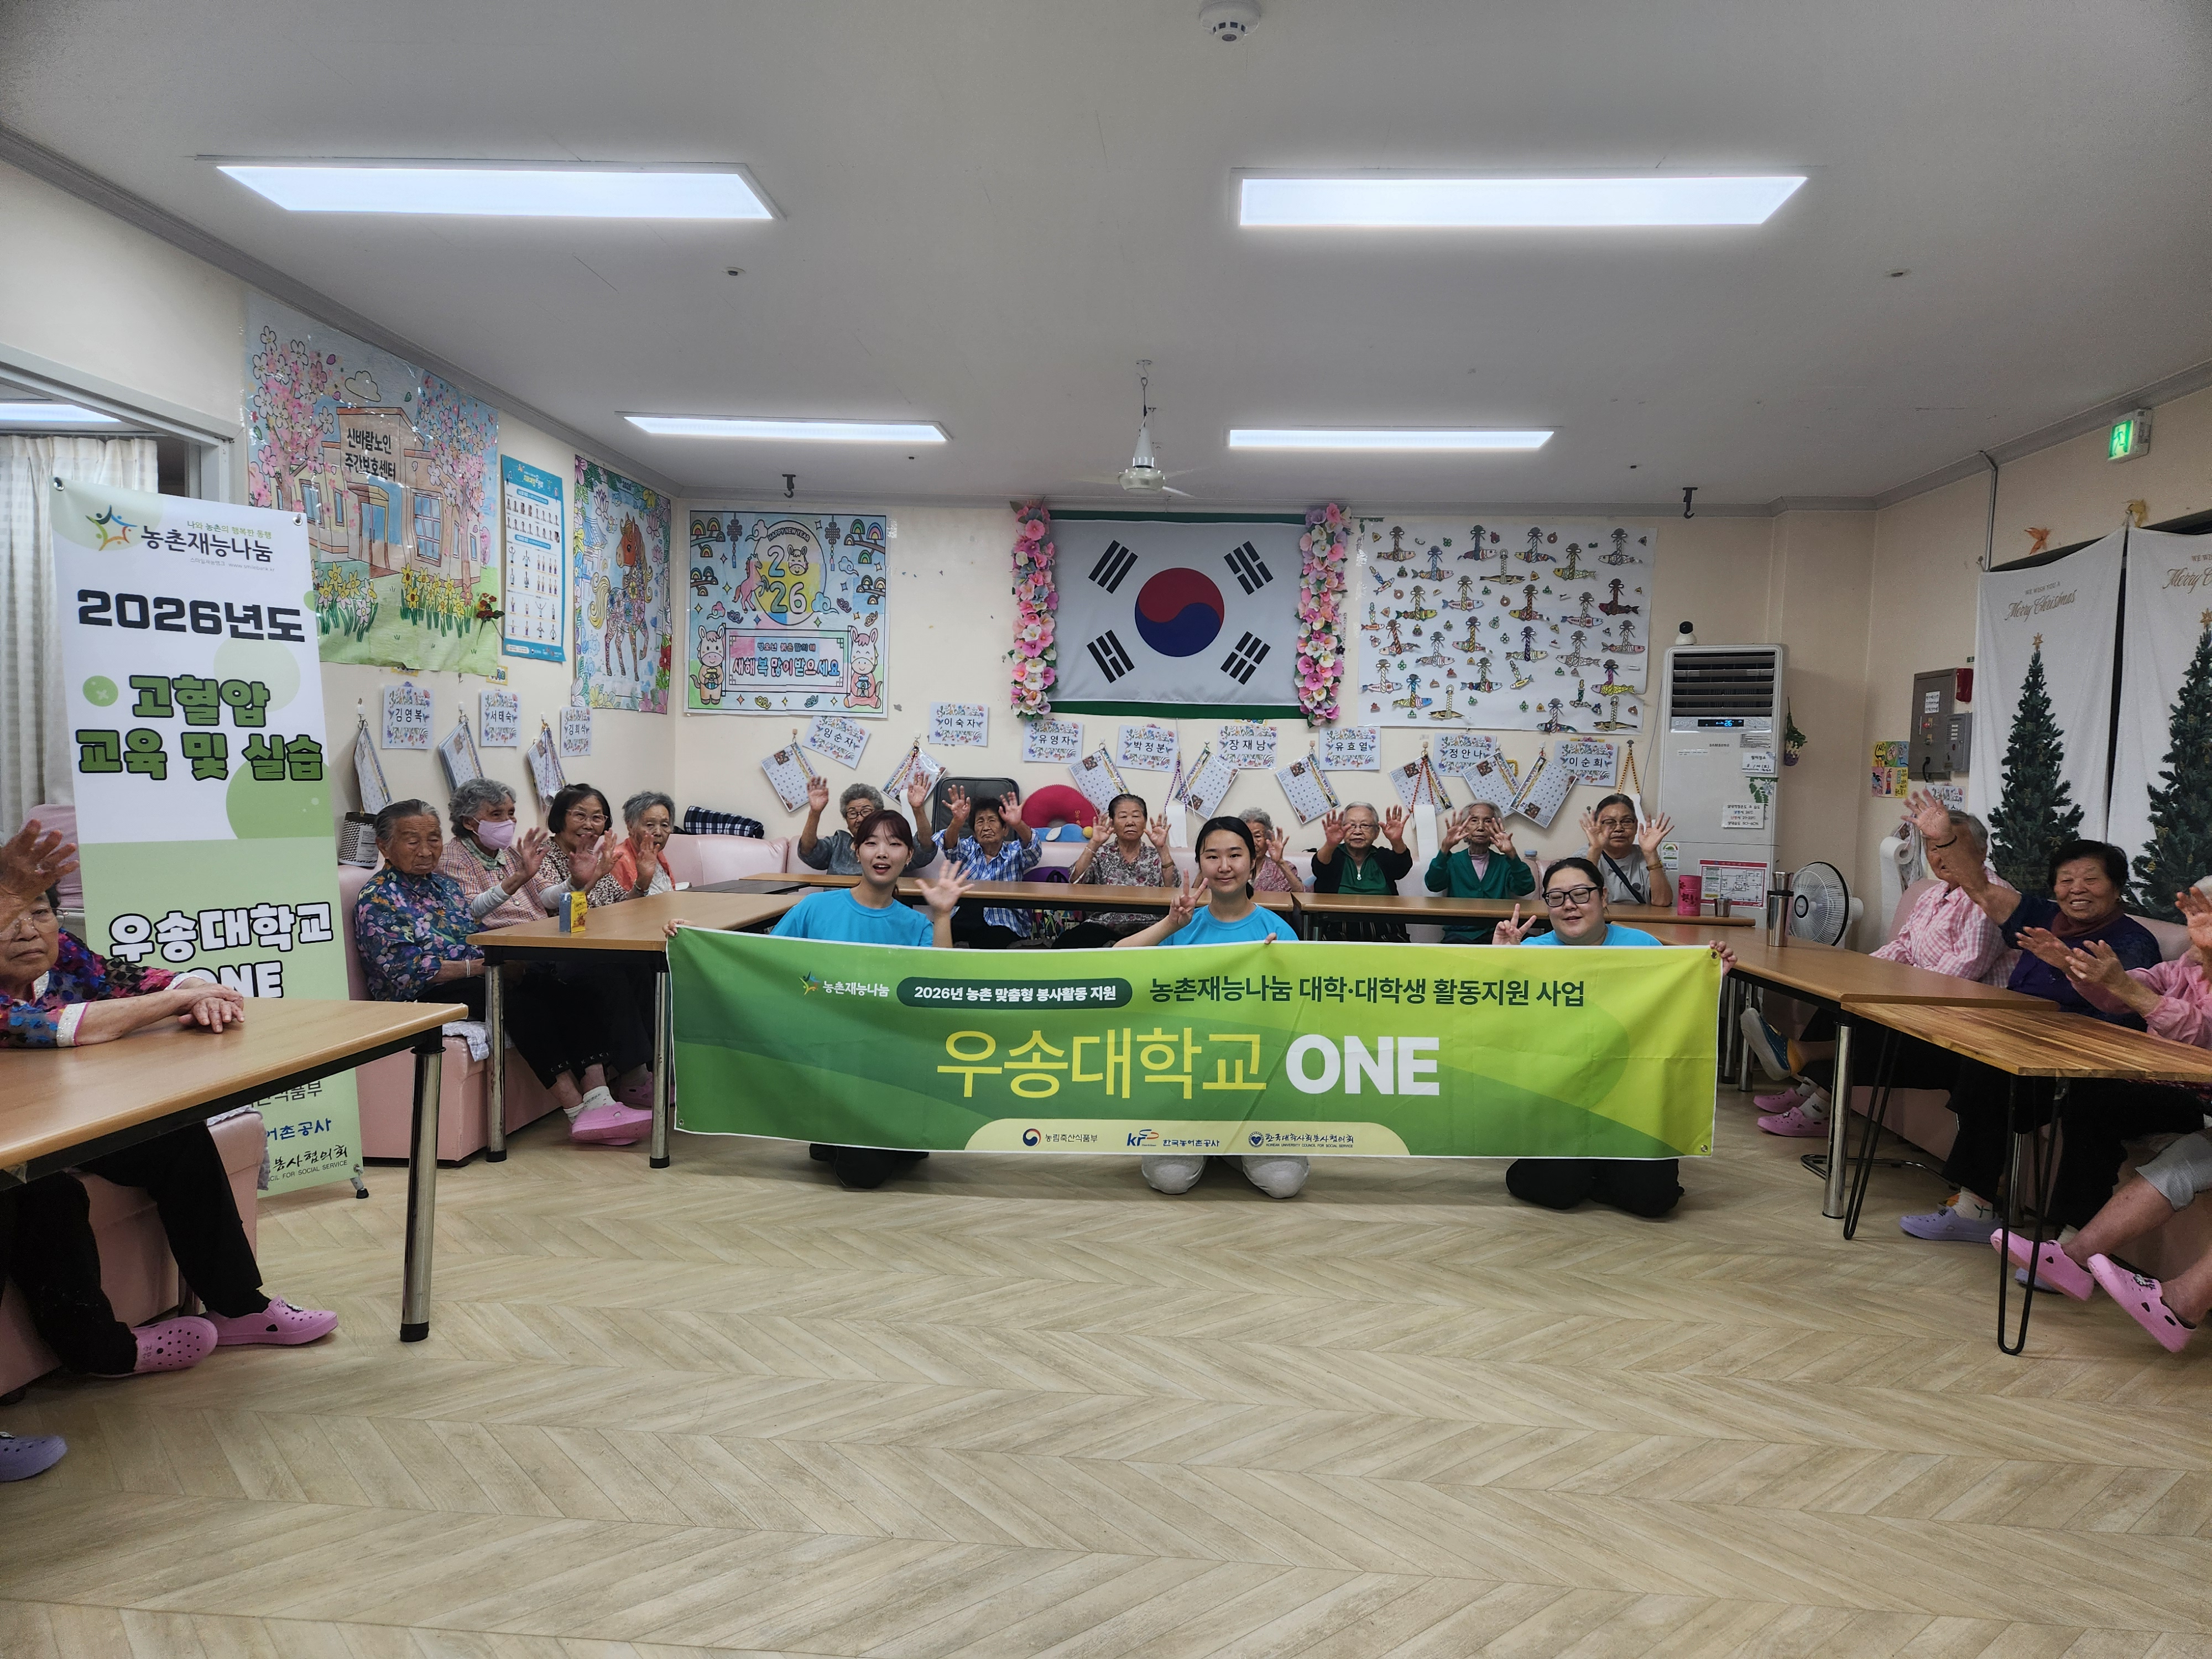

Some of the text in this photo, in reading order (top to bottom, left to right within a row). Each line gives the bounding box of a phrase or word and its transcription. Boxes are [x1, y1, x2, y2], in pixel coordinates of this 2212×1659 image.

[347, 428, 392, 455] 신바람노인
[345, 452, 395, 482] 주간보호센터
[187, 520, 272, 539] 나와 농촌의 행복한 동행
[767, 527, 785, 542] HAPPY
[796, 528, 811, 542] YEAR
[141, 525, 273, 562] 농촌재능나눔
[2163, 567, 2203, 594] Merry
[2005, 589, 2077, 622] Merry Christmas
[77, 589, 305, 642] 2026년도
[757, 642, 777, 651] 병오년
[794, 643, 808, 651] 말의
[733, 657, 840, 677] 새해 복 많이 받으세요
[129, 674, 270, 727] 고혈압
[395, 708, 422, 722] 김영복
[491, 710, 512, 723] 서태숙
[945, 718, 975, 728] 이숙자
[568, 723, 586, 735] 김희석
[824, 728, 853, 747] 임순자
[1039, 734, 1070, 745] 유영자
[1134, 741, 1165, 753] 박정분
[1229, 739, 1266, 750] 장재남
[1335, 742, 1368, 752] 유효열
[75, 728, 323, 781] 교육 및 실습
[1449, 748, 1483, 759] 정안나
[1569, 757, 1603, 768] 이순희
[109, 902, 333, 963] 우송대학교
[822, 980, 890, 998] 농촌재능나눔
[914, 985, 1117, 1003] 2026년 농촌 맞춤형 봉사활동 지원
[1150, 975, 1292, 1003] 농촌재능나눔
[1433, 977, 1528, 1006] 활동지원
[1536, 980, 1584, 1008] 사업
[937, 1027, 1439, 1099] 우송대학교 ONE
[267, 1117, 332, 1141] 어촌공사
[1045, 1134, 1098, 1144] 농림축산식품부
[1163, 1139, 1220, 1147] 한국농어촌공사
[1265, 1133, 1354, 1144] 한국대학사회봉사협의회
[269, 1145, 348, 1173] 봉사협의회
[298, 1166, 320, 1176] SOCIAL
[322, 1160, 348, 1170] SERVICE
